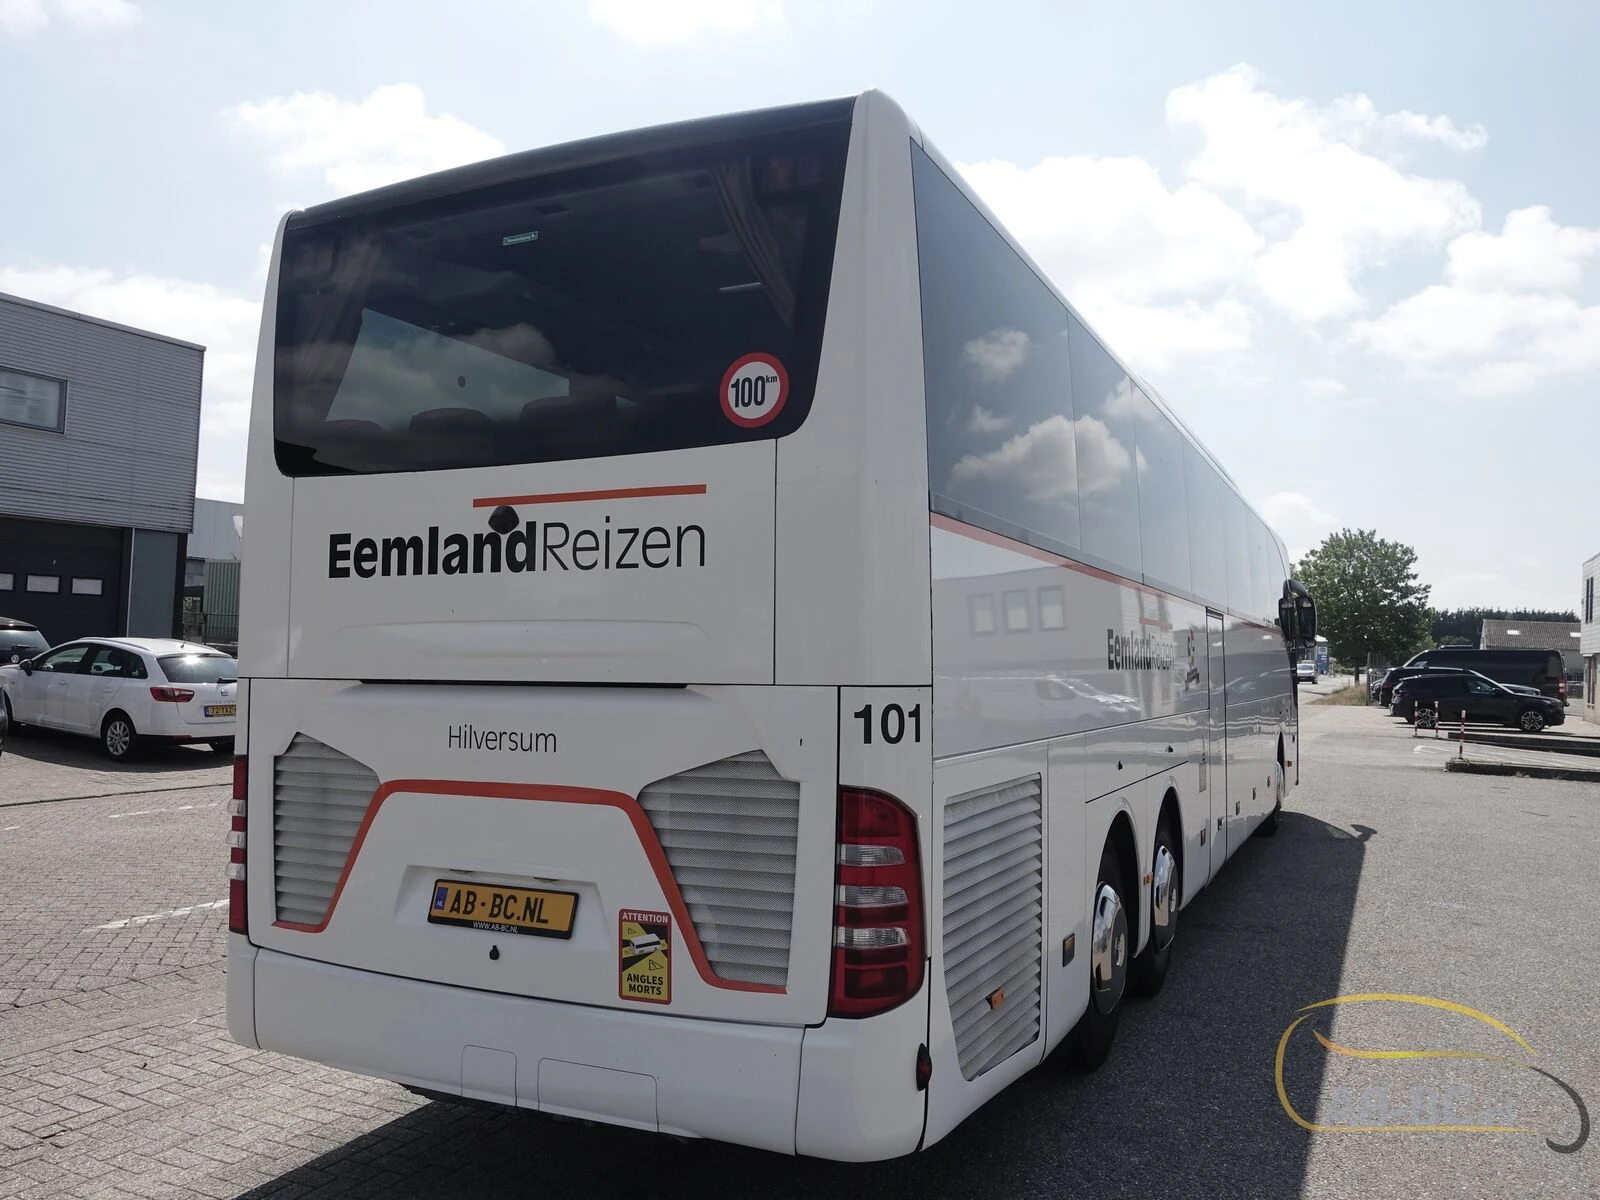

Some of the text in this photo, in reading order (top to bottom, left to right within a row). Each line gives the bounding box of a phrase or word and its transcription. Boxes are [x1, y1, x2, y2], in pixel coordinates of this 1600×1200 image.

[853, 703, 921, 745] 101
[448, 723, 557, 753] Hilversum
[622, 912, 668, 923] ATTENTION
[626, 973, 664, 986] ANGLES
[628, 983, 662, 996] MORTS
